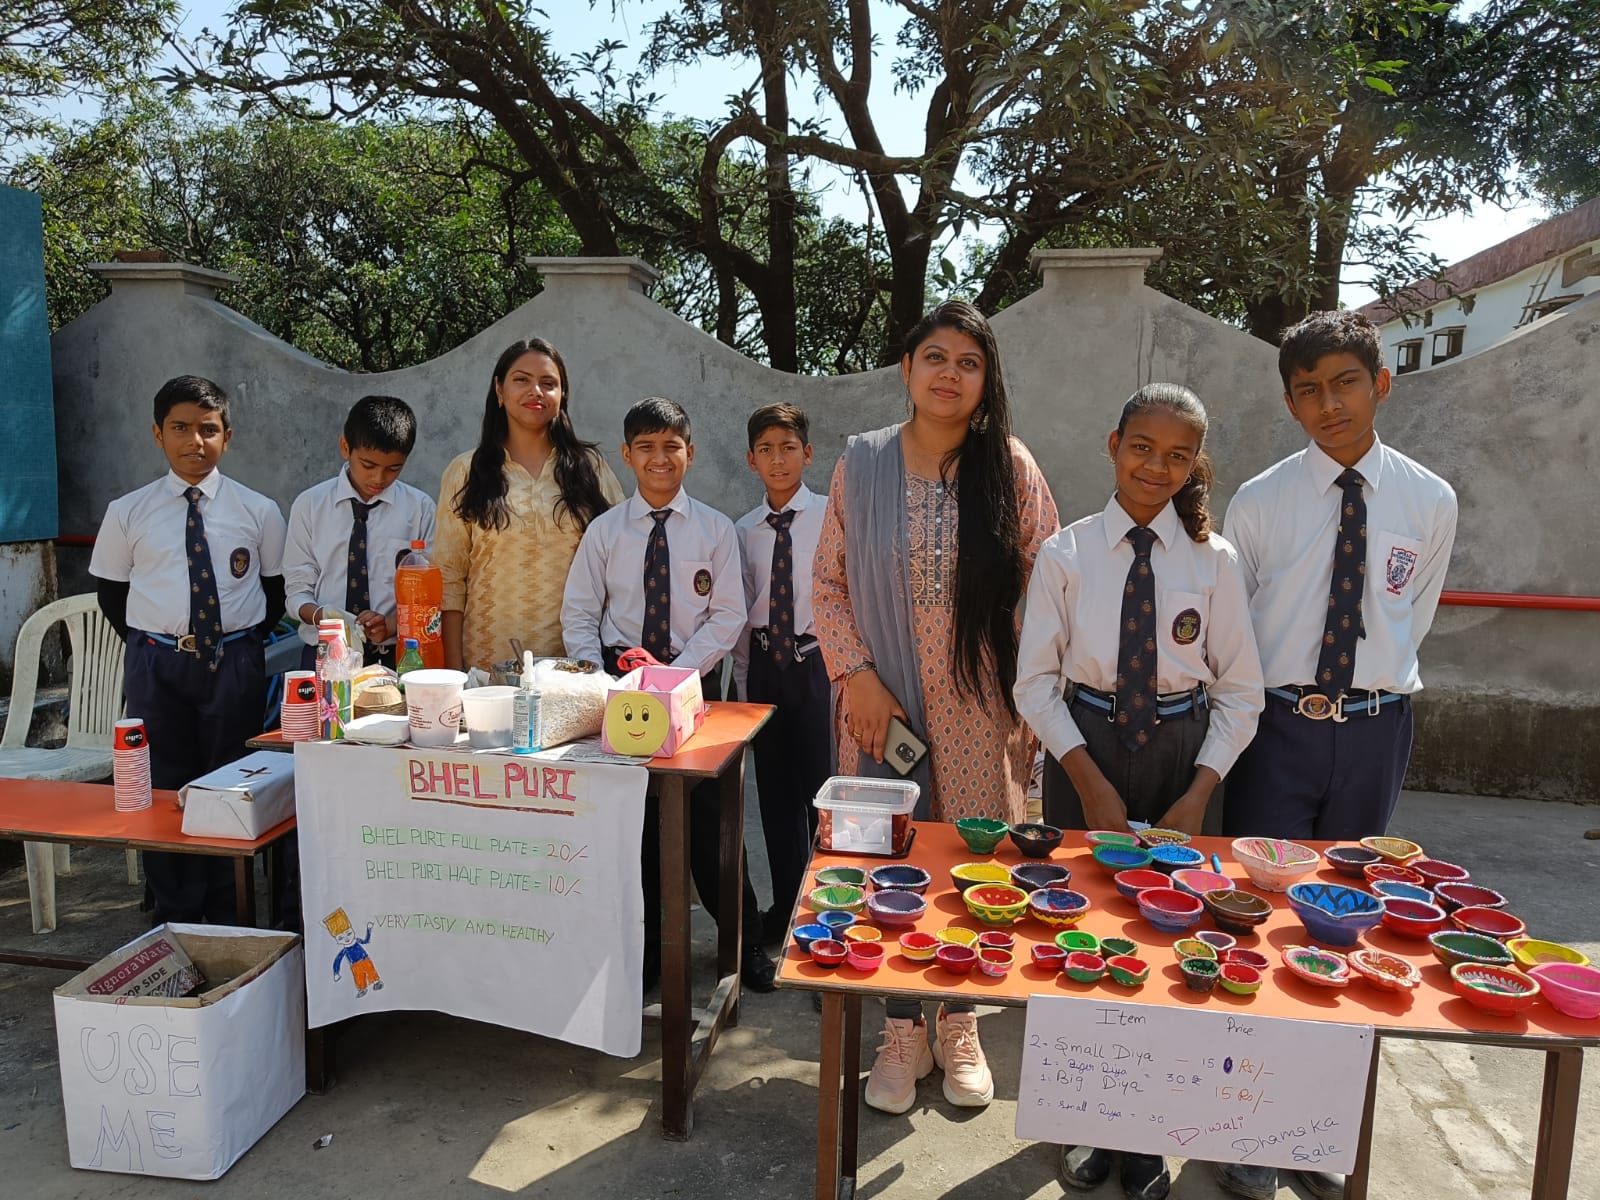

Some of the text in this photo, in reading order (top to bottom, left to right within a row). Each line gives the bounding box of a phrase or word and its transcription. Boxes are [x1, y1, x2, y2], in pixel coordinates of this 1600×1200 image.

[409, 760, 576, 801] BHEL PURI
[361, 825, 405, 846] BHEL
[410, 828, 446, 848] PURI
[452, 834, 482, 852] FULL
[365, 861, 404, 880] BHEL
[411, 863, 442, 882] PURI
[449, 866, 481, 887] HALF
[374, 914, 554, 944] VERY TASTY AND HEALTHY
[90, 943, 171, 995] SignoraWare
[142, 967, 168, 988] SIDE
[1096, 1008, 1146, 1027] Item
[1227, 1016, 1254, 1037] Price
[81, 1024, 201, 1096] USE
[1054, 1036, 1105, 1058] Small
[1112, 1043, 1154, 1066] Diya
[1056, 1070, 1084, 1092] Big
[1103, 1075, 1144, 1095] Diya
[1215, 1086, 1233, 1100] 15
[89, 1105, 182, 1171] ME
[1292, 1142, 1342, 1163] Sale
